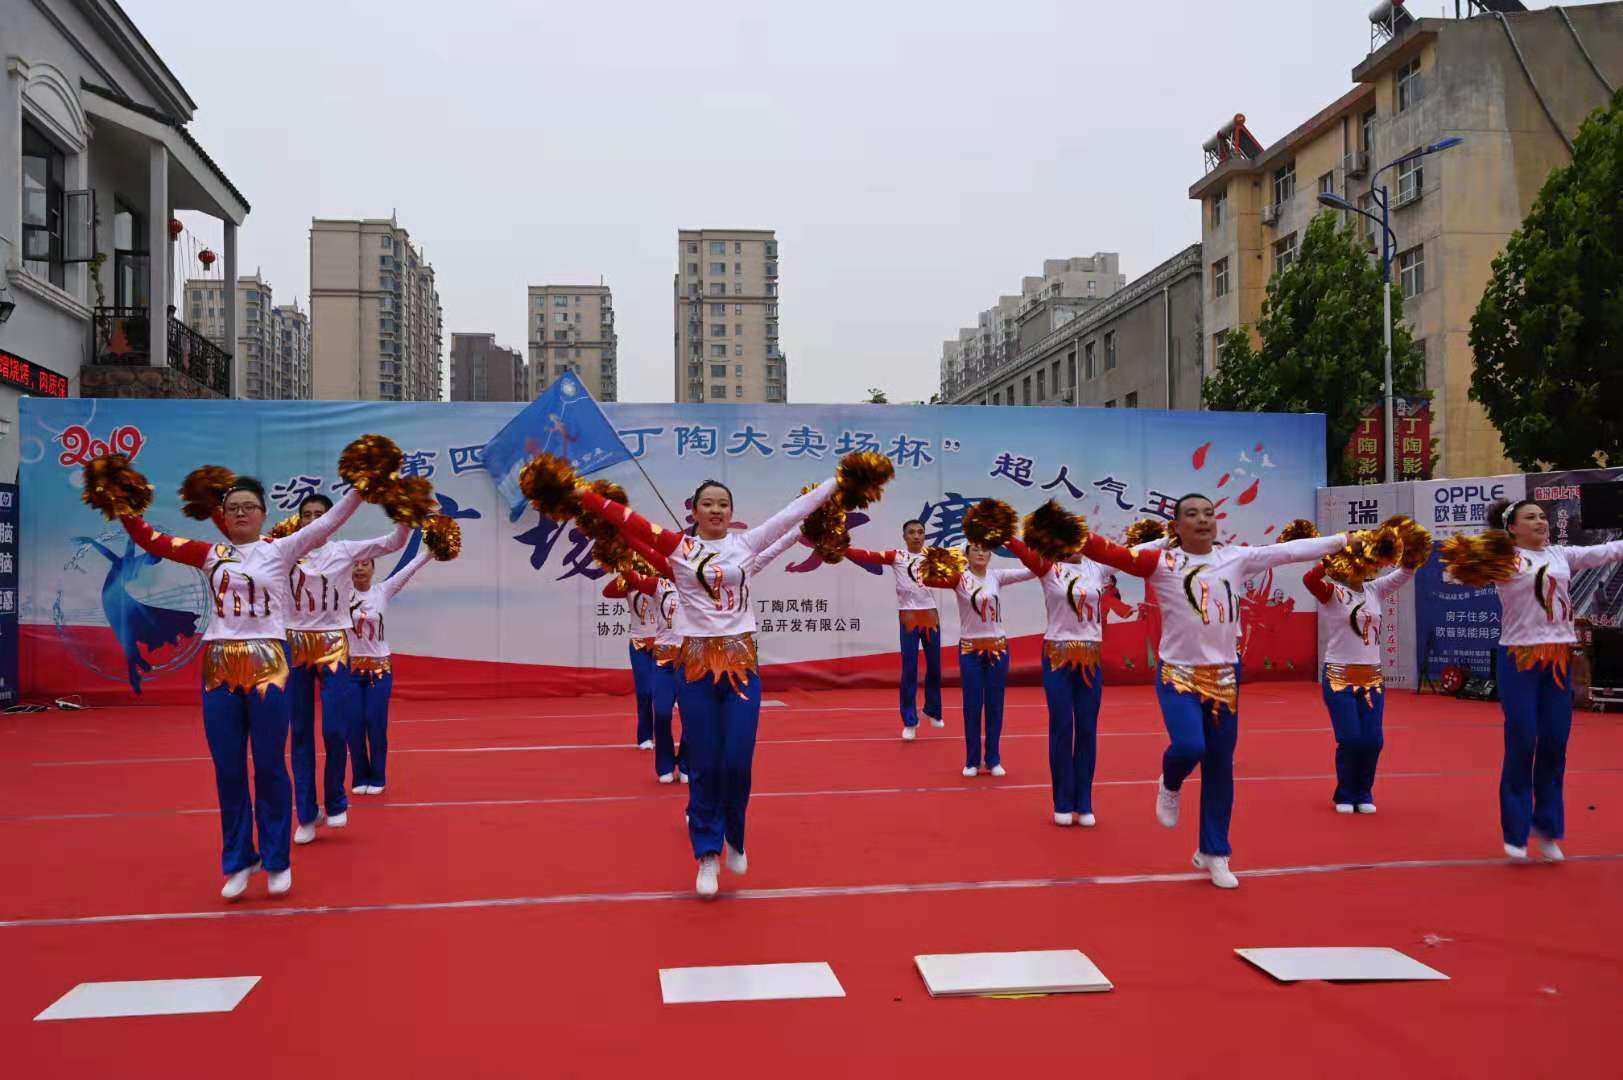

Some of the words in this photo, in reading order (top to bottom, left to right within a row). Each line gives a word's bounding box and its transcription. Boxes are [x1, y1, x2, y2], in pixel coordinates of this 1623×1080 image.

[52, 425, 144, 467] 2019
[1403, 418, 1422, 481] 丁陶影
[990, 452, 1177, 521] 超人气王
[1435, 485, 1504, 503] OPPLE
[1348, 500, 1378, 524] 瑞
[1435, 504, 1490, 522] 欧普照
[597, 602, 631, 616] 主办
[757, 599, 828, 613] 丁陶风情街
[597, 622, 632, 636] 协办
[755, 618, 861, 632] 品开发有限公司
